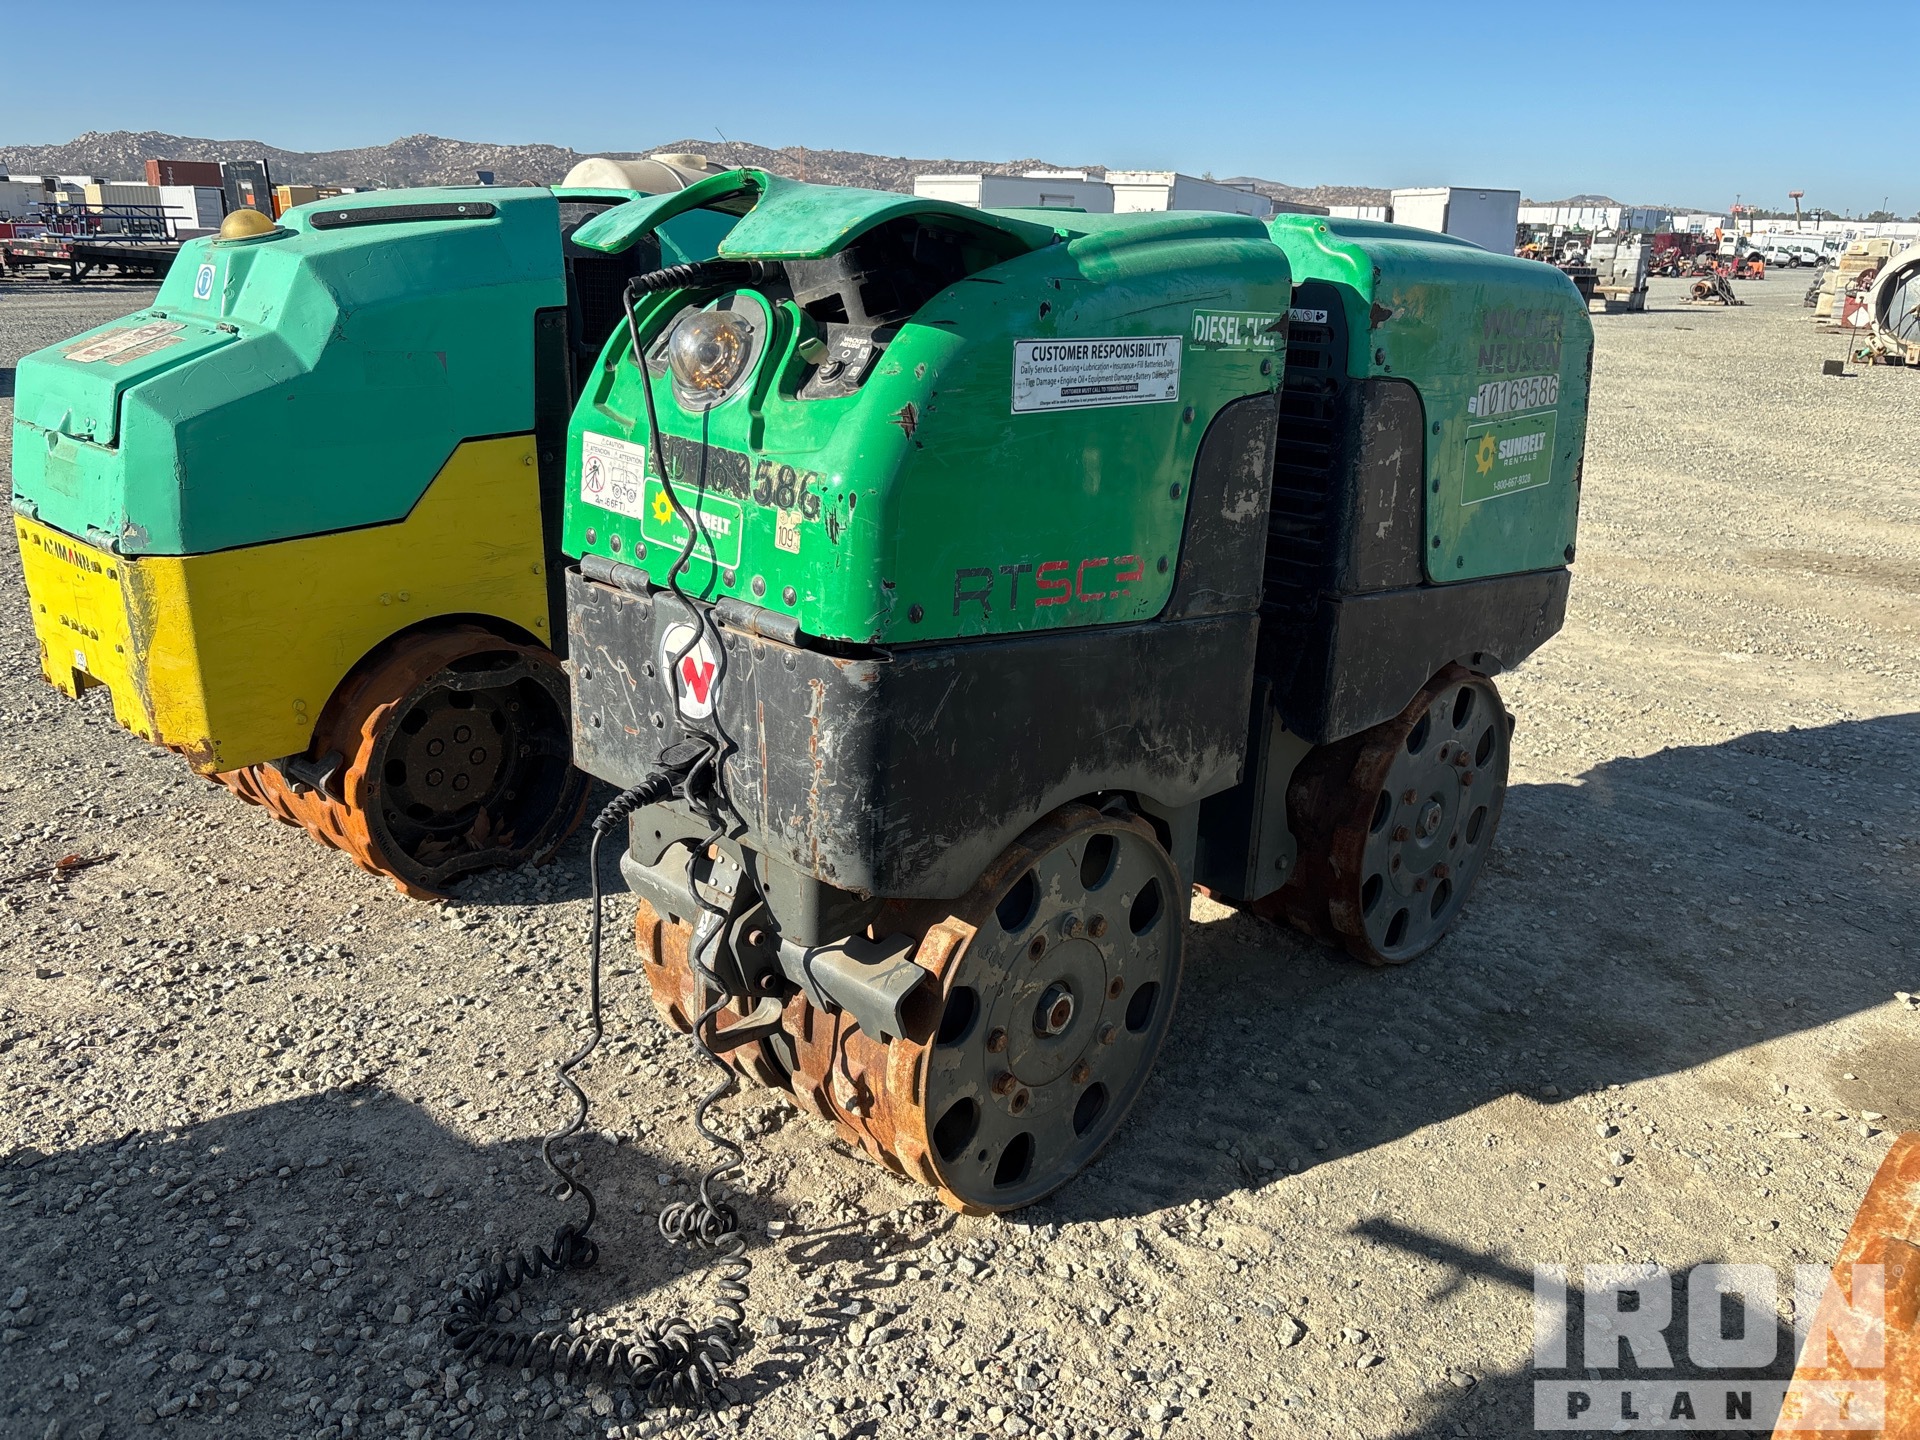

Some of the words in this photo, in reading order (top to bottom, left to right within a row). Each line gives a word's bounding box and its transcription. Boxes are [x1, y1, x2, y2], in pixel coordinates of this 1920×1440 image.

[1194, 315, 1240, 345] DIESEL
[1032, 345, 1088, 361] CUSTOMER
[1091, 342, 1167, 360] RESPONSIBILITY
[1020, 365, 1033, 375] Daily
[1034, 364, 1053, 374] Service
[1053, 364, 1058, 373] &
[1058, 363, 1079, 374] Cleaning
[1083, 361, 1110, 372] Lubrication
[1112, 361, 1134, 370] Insurance
[1136, 360, 1144, 369] Fill
[1144, 359, 1163, 369] Batteries
[1163, 359, 1175, 369] Daily
[1036, 376, 1057, 388] Damage
[1060, 375, 1077, 386] Engine
[1077, 375, 1085, 383] Oil
[1088, 373, 1113, 385] Equipment
[1114, 373, 1133, 382] Damage
[1135, 371, 1151, 381] Battery
[1480, 376, 1558, 415] 10169586
[605, 439, 625, 450] CAUTION
[1498, 432, 1546, 459] SUNBELT
[619, 453, 643, 465] ATTENTION
[1503, 452, 1537, 466] RENTALS
[778, 526, 794, 548] 109
[953, 555, 1144, 616] RTSC3
